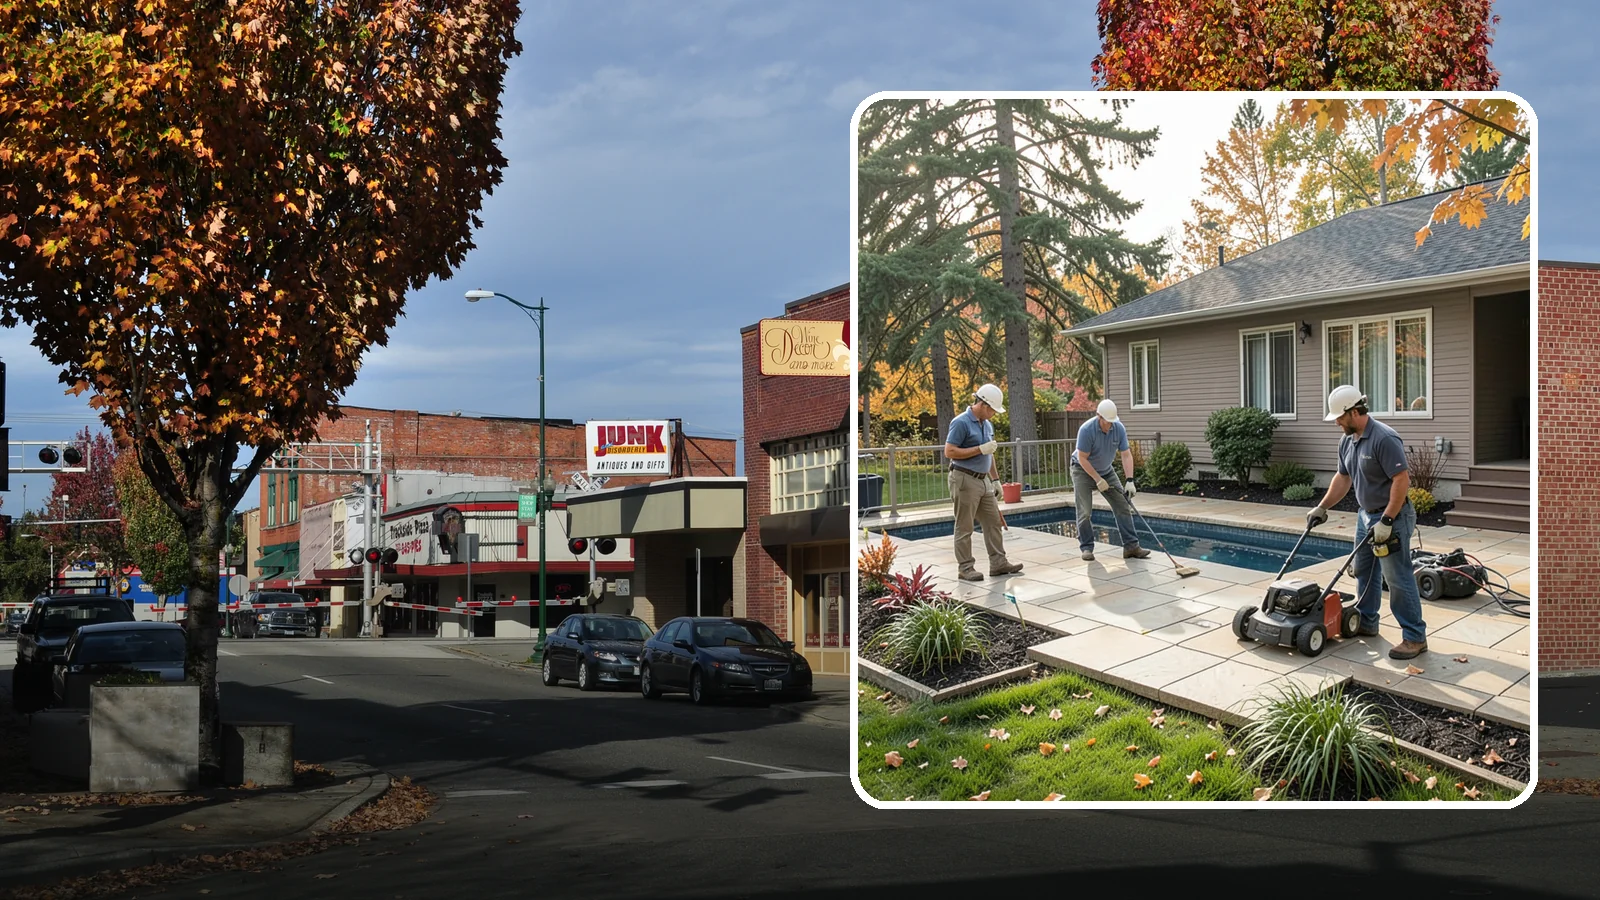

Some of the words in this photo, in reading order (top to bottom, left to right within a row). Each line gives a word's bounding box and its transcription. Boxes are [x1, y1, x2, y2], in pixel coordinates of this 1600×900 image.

[764, 327, 831, 366] Decor
[595, 425, 665, 457] JUNK
[596, 461, 628, 470] ANTIQUES
[631, 461, 644, 470] AND
[646, 460, 665, 469] GIFTS
[390, 522, 413, 540] Trackside
[414, 519, 429, 535] Pizza
